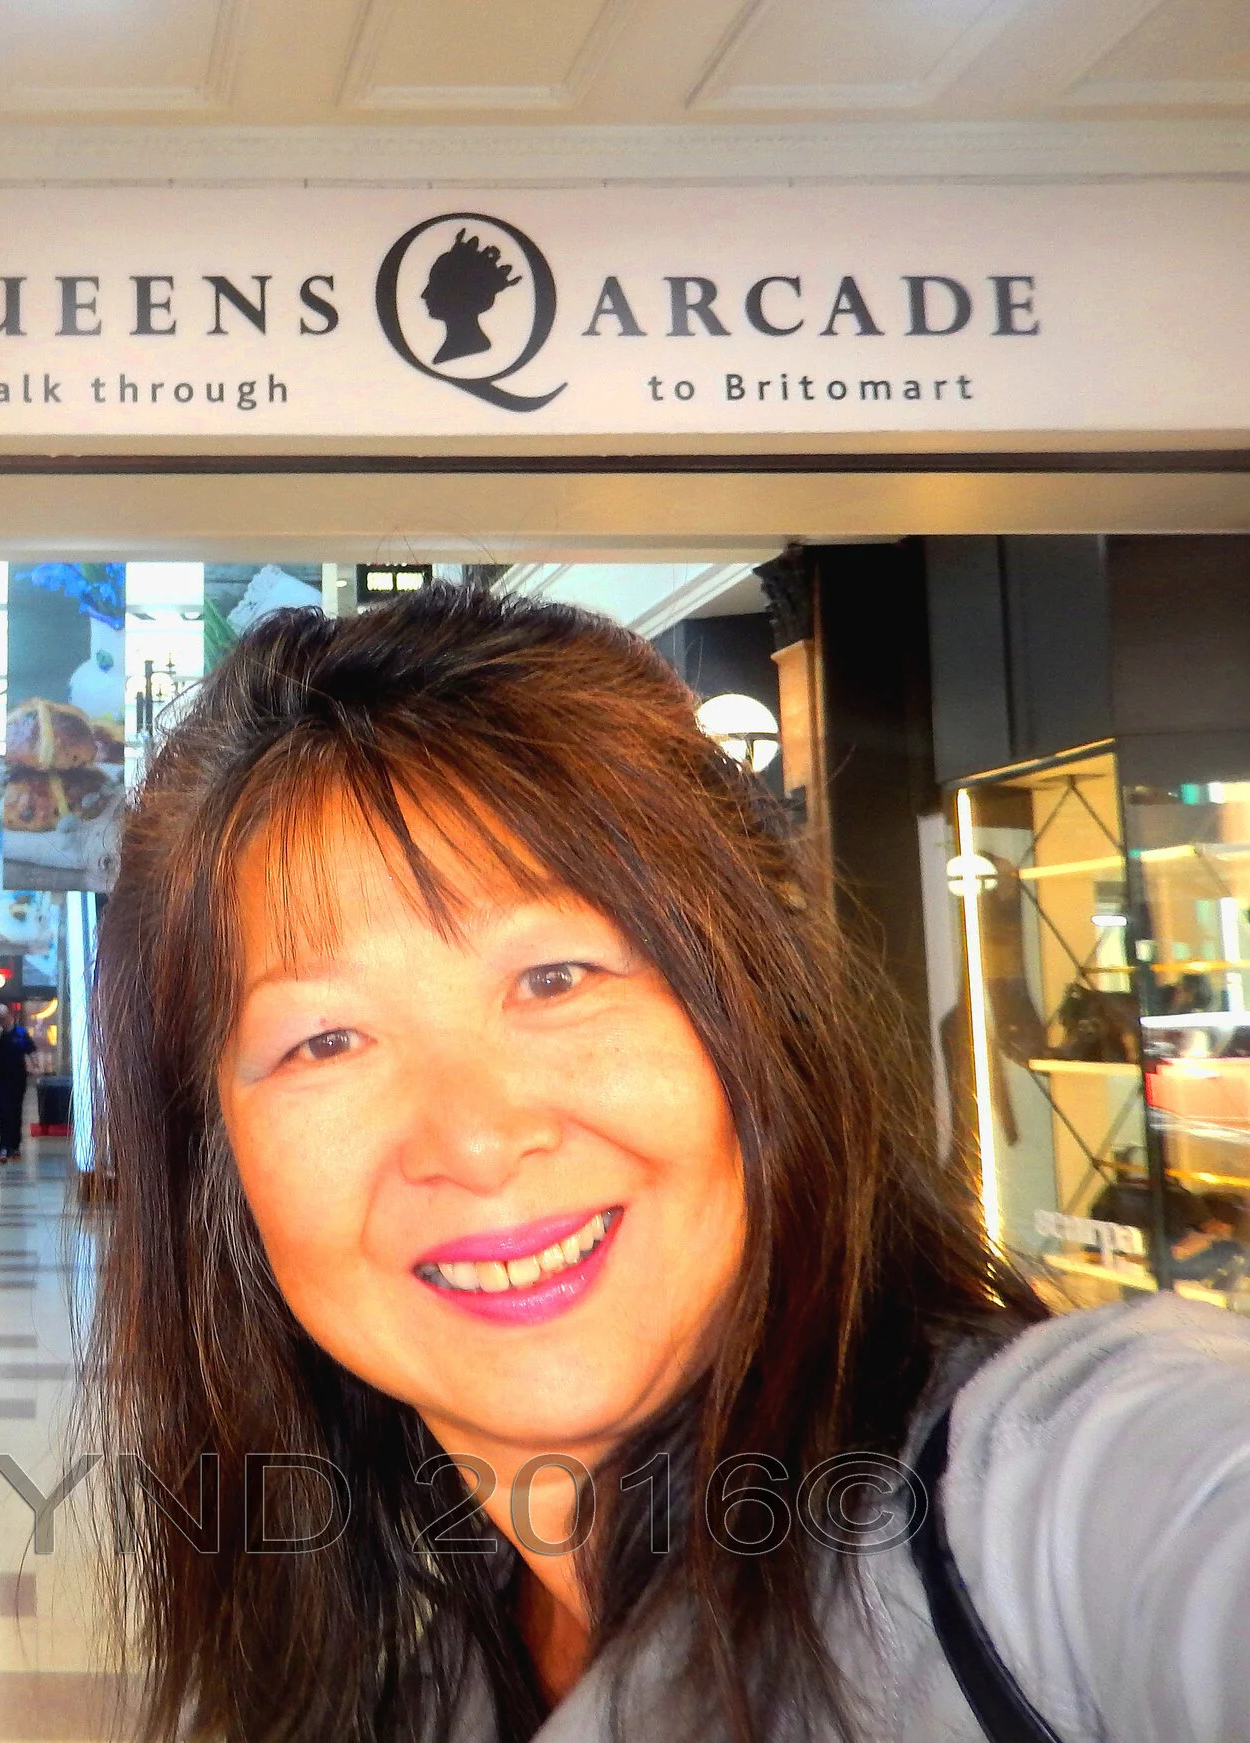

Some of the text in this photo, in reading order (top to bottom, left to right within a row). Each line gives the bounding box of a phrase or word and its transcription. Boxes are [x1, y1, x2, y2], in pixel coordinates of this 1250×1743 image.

[581, 275, 1041, 337] ARCADE
[91, 374, 289, 411] through
[649, 375, 695, 402] to
[726, 374, 973, 402] Britomart
